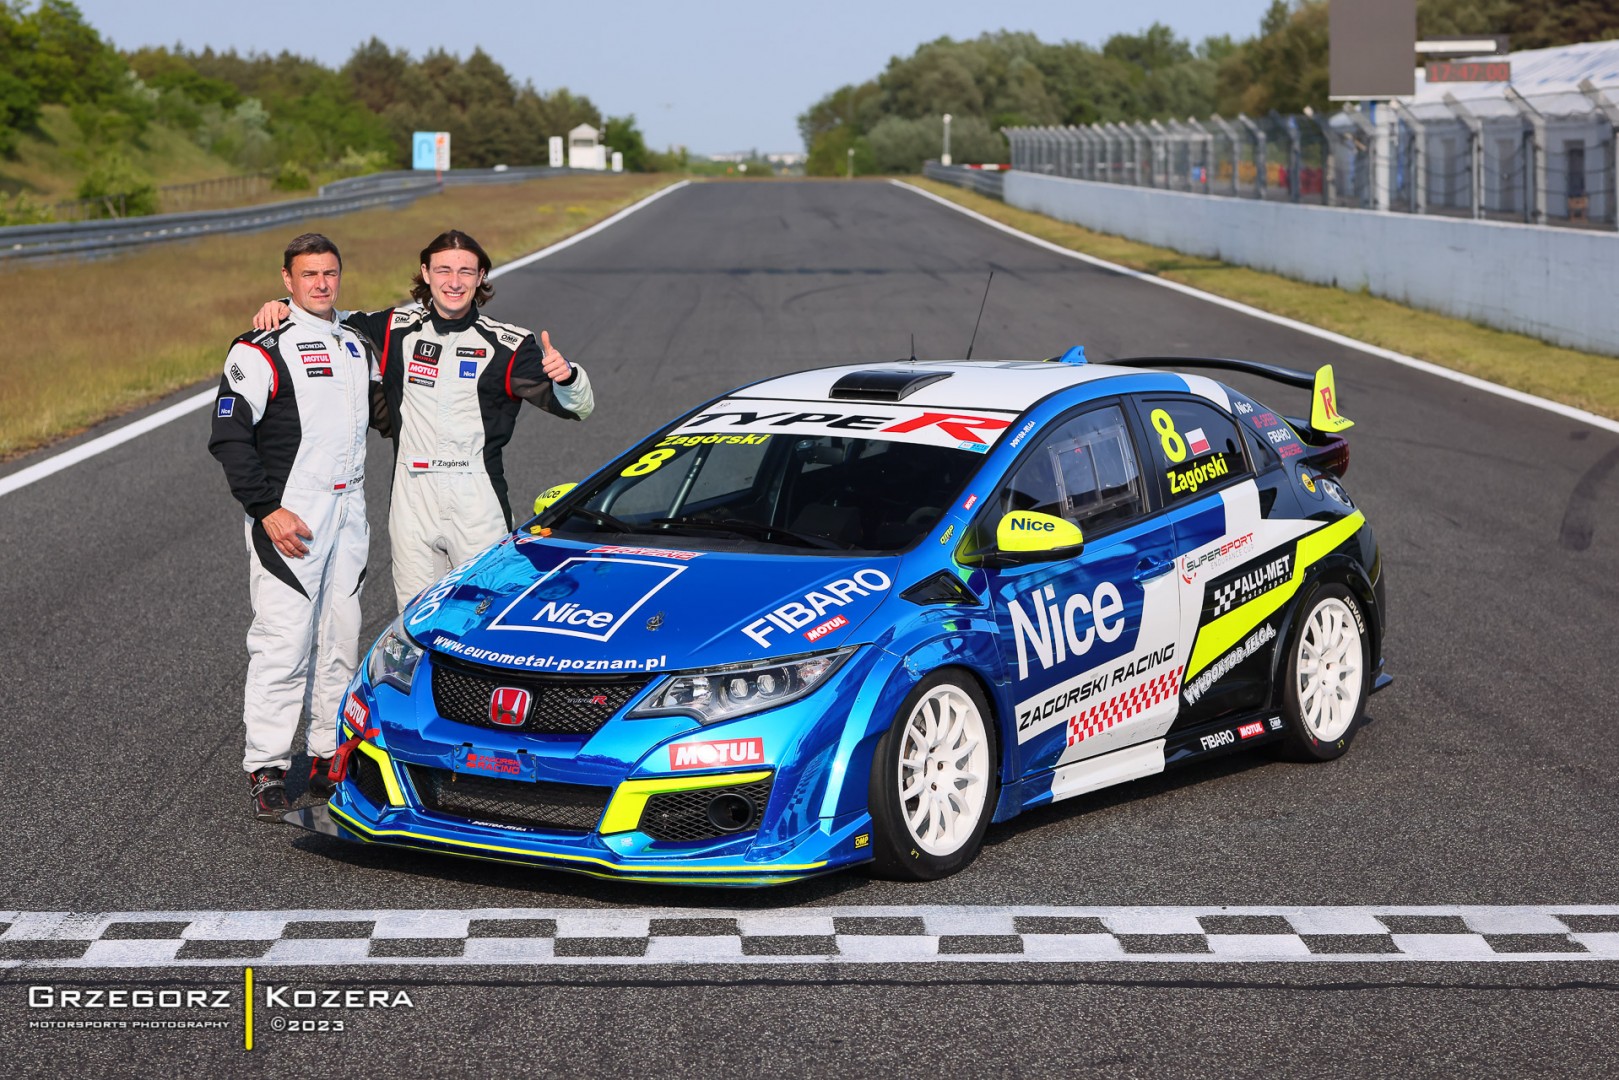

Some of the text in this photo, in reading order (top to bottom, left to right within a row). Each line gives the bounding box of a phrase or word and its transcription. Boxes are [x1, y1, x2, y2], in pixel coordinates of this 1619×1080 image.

[298, 342, 325, 350] HONDA
[501, 334, 518, 343] OMP
[303, 354, 330, 364] MOTUL
[474, 349, 485, 357] R
[230, 365, 244, 382] OMP
[410, 364, 437, 376] MOTUL
[1234, 401, 1254, 415] Nice
[1320, 386, 1339, 420] R
[655, 432, 766, 448] Zagórski
[684, 411, 1012, 445] TYPE R
[1150, 408, 1187, 463] 8
[1267, 428, 1292, 444] FIBARO
[620, 448, 676, 478] 8
[1166, 452, 1229, 494] Zagórski
[1010, 518, 1055, 532] Nice
[1187, 532, 1253, 572] SUPERSPORT
[1241, 554, 1290, 594] ALU-MET
[1241, 572, 1293, 603] motorsport
[532, 602, 613, 629] Nice
[741, 568, 891, 648] FIBARO
[1344, 595, 1365, 634] ADVAN
[807, 617, 846, 642] MOTUL
[1007, 581, 1125, 681] Nice
[432, 634, 667, 671] www.eurometal-poznan.pl
[1111, 642, 1176, 687] RACING
[345, 694, 367, 728] MOTUL
[1199, 729, 1235, 751] FIBARO
[1239, 722, 1263, 737] MOTUL
[675, 740, 761, 767] MOTUL
[477, 761, 521, 775] RACING
[855, 835, 869, 847] OMP
